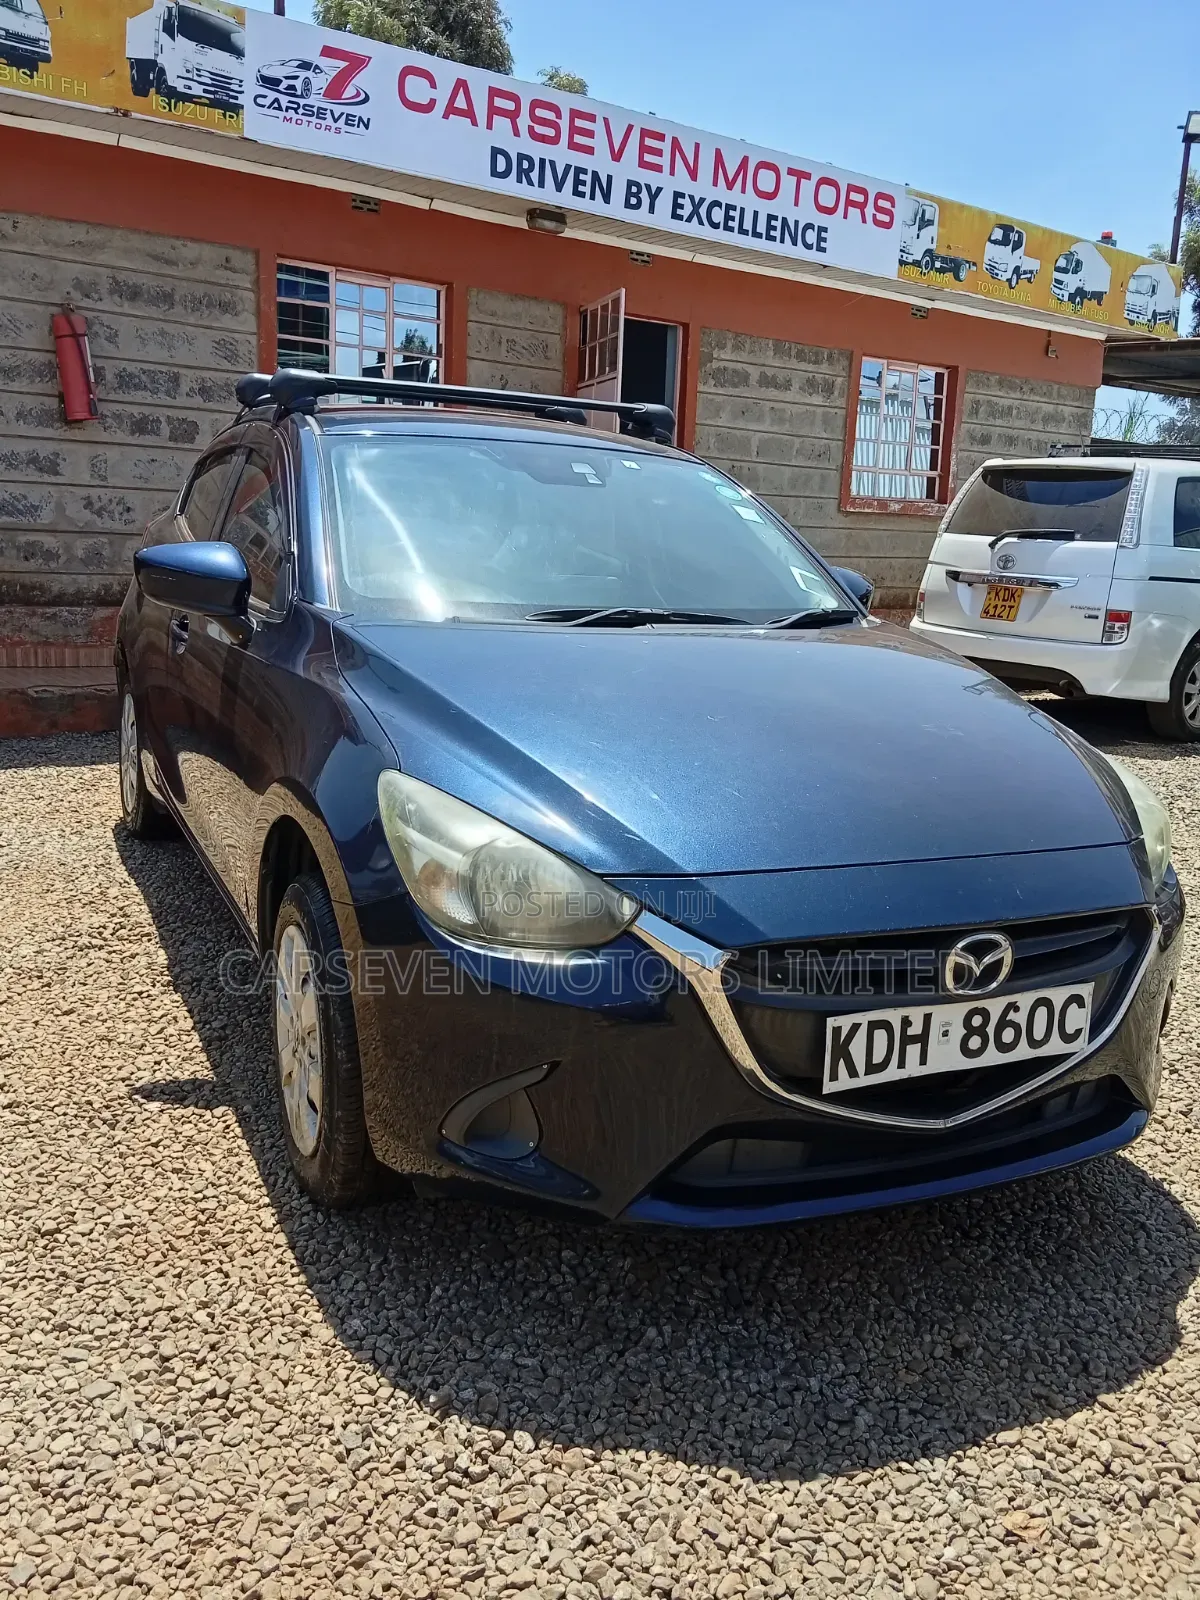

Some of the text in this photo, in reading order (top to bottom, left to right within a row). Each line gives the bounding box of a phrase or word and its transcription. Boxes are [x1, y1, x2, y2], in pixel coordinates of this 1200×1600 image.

[61, 77, 87, 97] FH
[152, 95, 208, 120] ISUZU
[253, 94, 371, 130] CARSEVEN
[282, 115, 343, 134] MOTORS
[397, 64, 896, 230] CARSEVEN MOTORS
[489, 145, 829, 253] DRIVEN BY EXCELLENCE
[901, 264, 950, 284] ISUZU NMR
[977, 281, 1032, 302] TOYOTA DYNA
[1048, 298, 1109, 321] MITSUBISHI FUSO
[994, 587, 1017, 603] KDK
[983, 603, 1015, 619] 412T
[828, 993, 1087, 1082] KDH 860C
